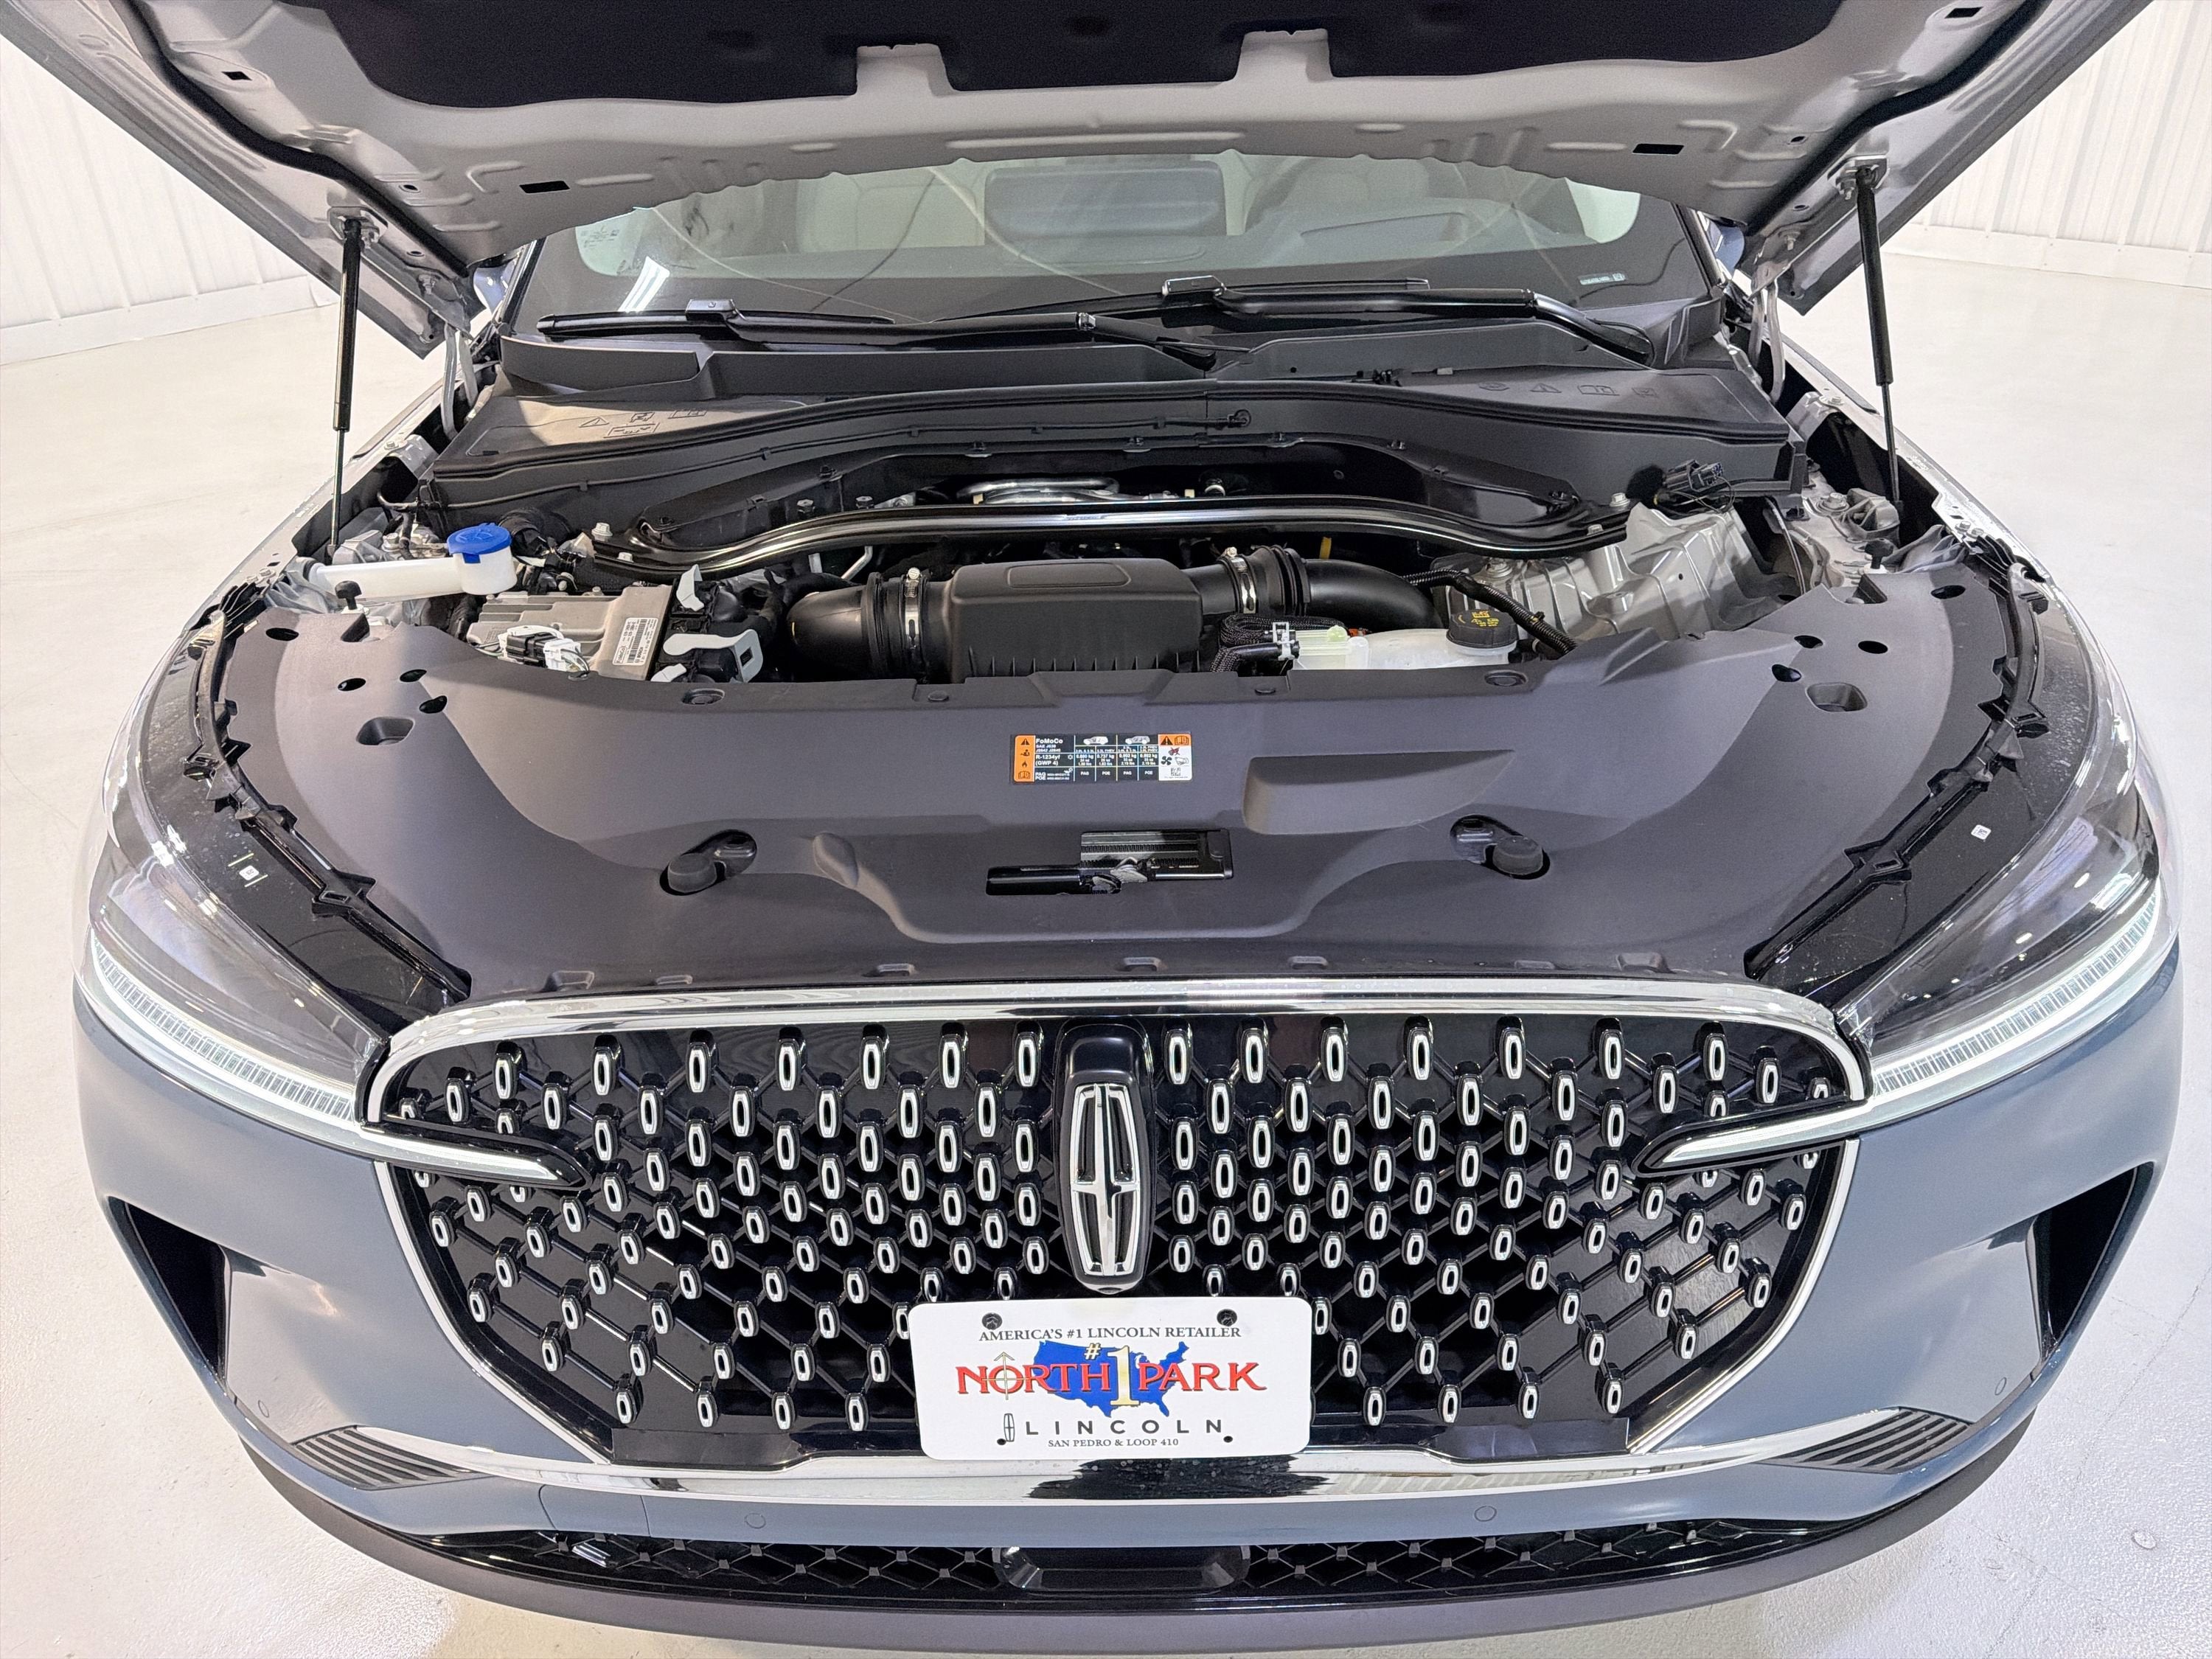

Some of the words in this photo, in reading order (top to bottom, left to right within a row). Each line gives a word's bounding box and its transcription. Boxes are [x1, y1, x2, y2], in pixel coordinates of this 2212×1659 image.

[979, 1329, 1062, 1341] AMERICA'S
[1067, 1329, 1082, 1338] #1
[1088, 1327, 1161, 1338] LINCOLN
[1165, 1327, 1242, 1338] RETAILER
[956, 1363, 1112, 1394] NORTH
[1138, 1363, 1267, 1391] PARK
[1026, 1419, 1222, 1436] LINCOLN
[1048, 1439, 1070, 1447] SAN
[1127, 1439, 1158, 1447] LOOP
